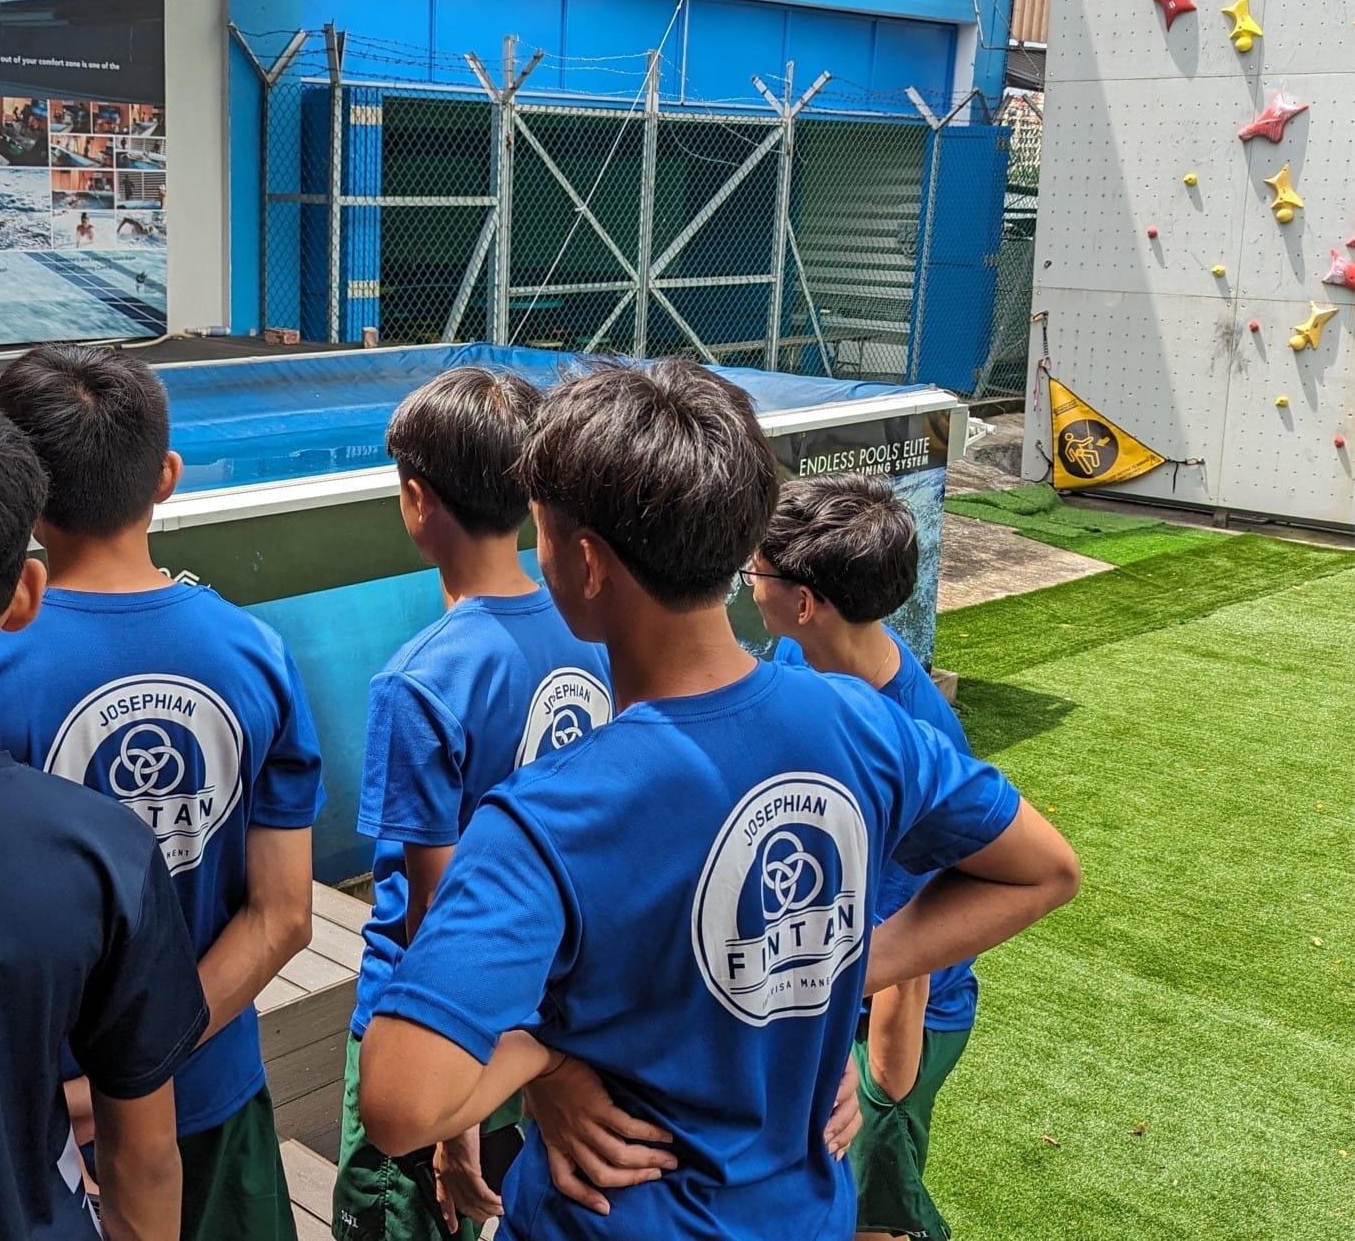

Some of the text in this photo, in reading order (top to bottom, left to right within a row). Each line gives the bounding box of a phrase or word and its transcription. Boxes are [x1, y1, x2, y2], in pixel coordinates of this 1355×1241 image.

[799, 449, 855, 477] ENDLESS
[903, 437, 930, 458] ELITE
[895, 454, 929, 471] SYSTEM
[100, 693, 197, 727] JOSEPHIAN
[147, 797, 214, 828] TAN
[743, 794, 828, 847] JOSEPHIAN
[727, 904, 855, 980] FINTAN
[800, 975, 832, 989] MANE
